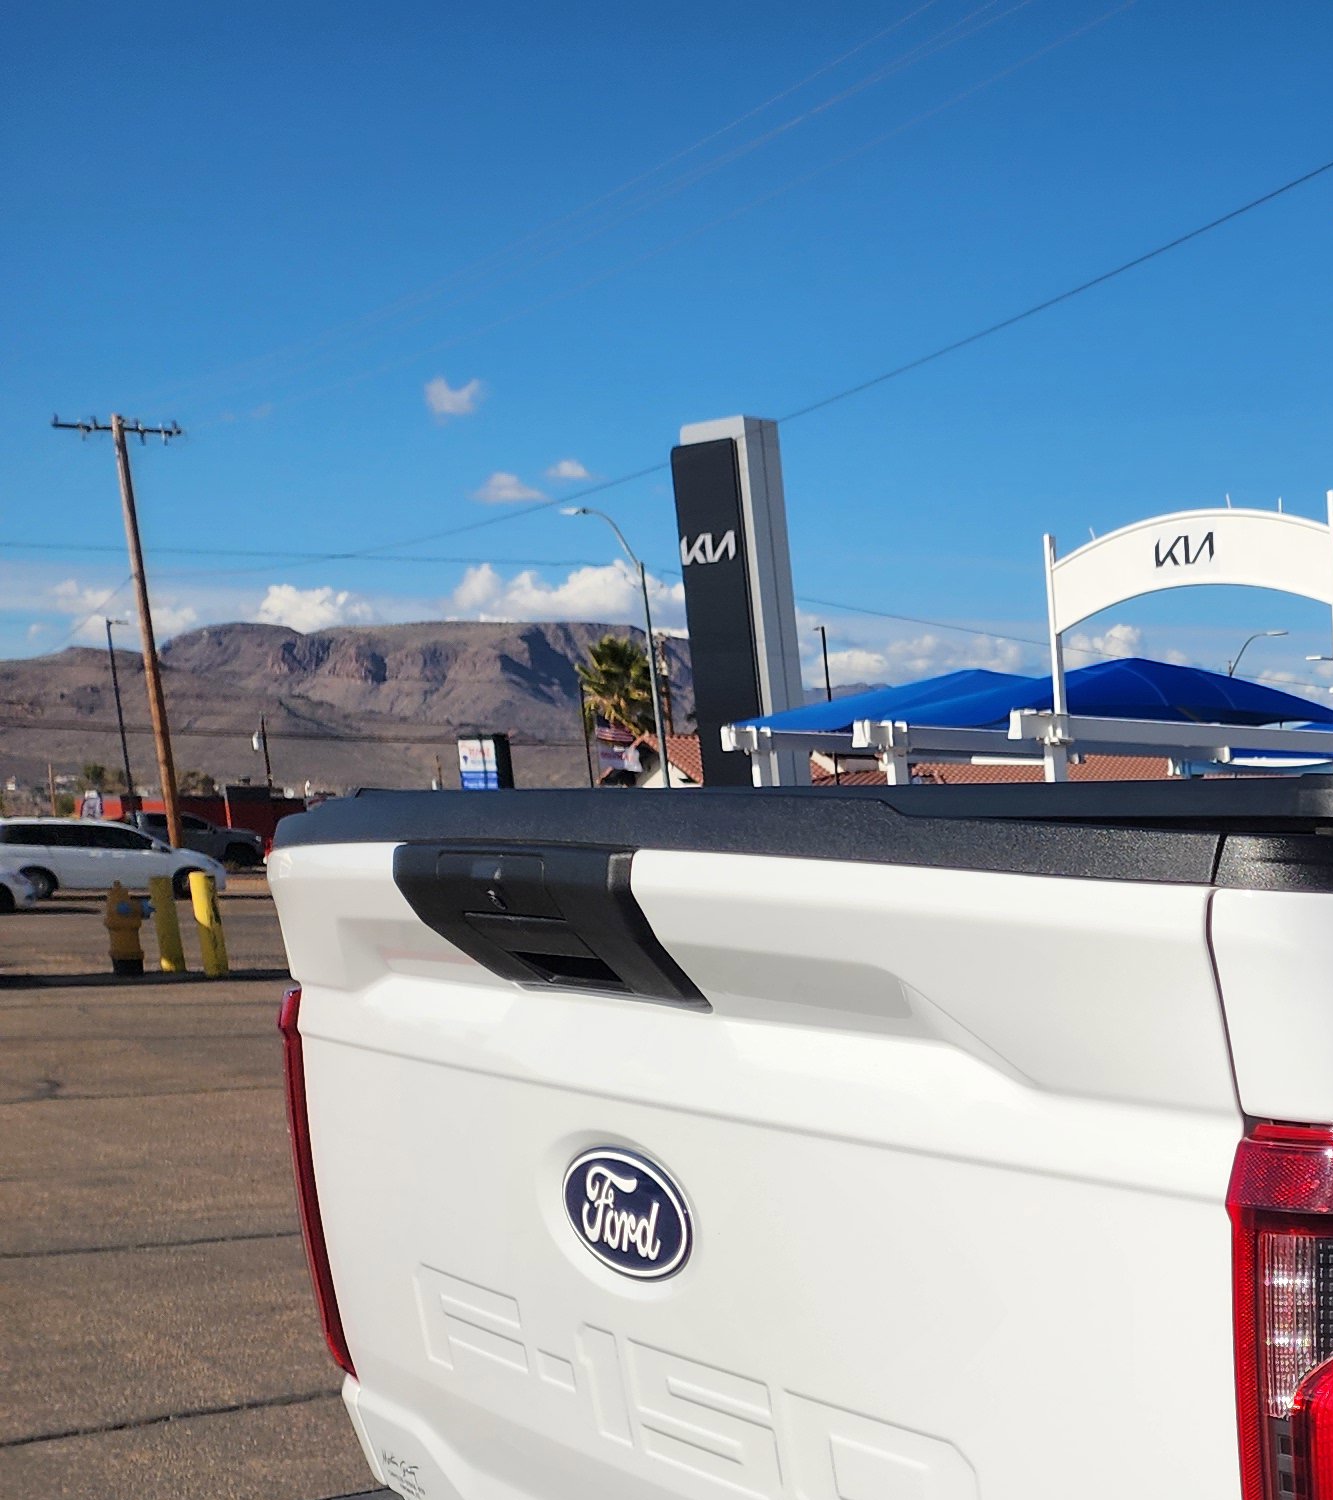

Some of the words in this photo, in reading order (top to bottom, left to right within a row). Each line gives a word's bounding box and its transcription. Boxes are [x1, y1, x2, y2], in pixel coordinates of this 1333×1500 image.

[680, 530, 736, 566] KIA
[1154, 531, 1215, 568] KIA
[582, 1165, 661, 1261] Ford
